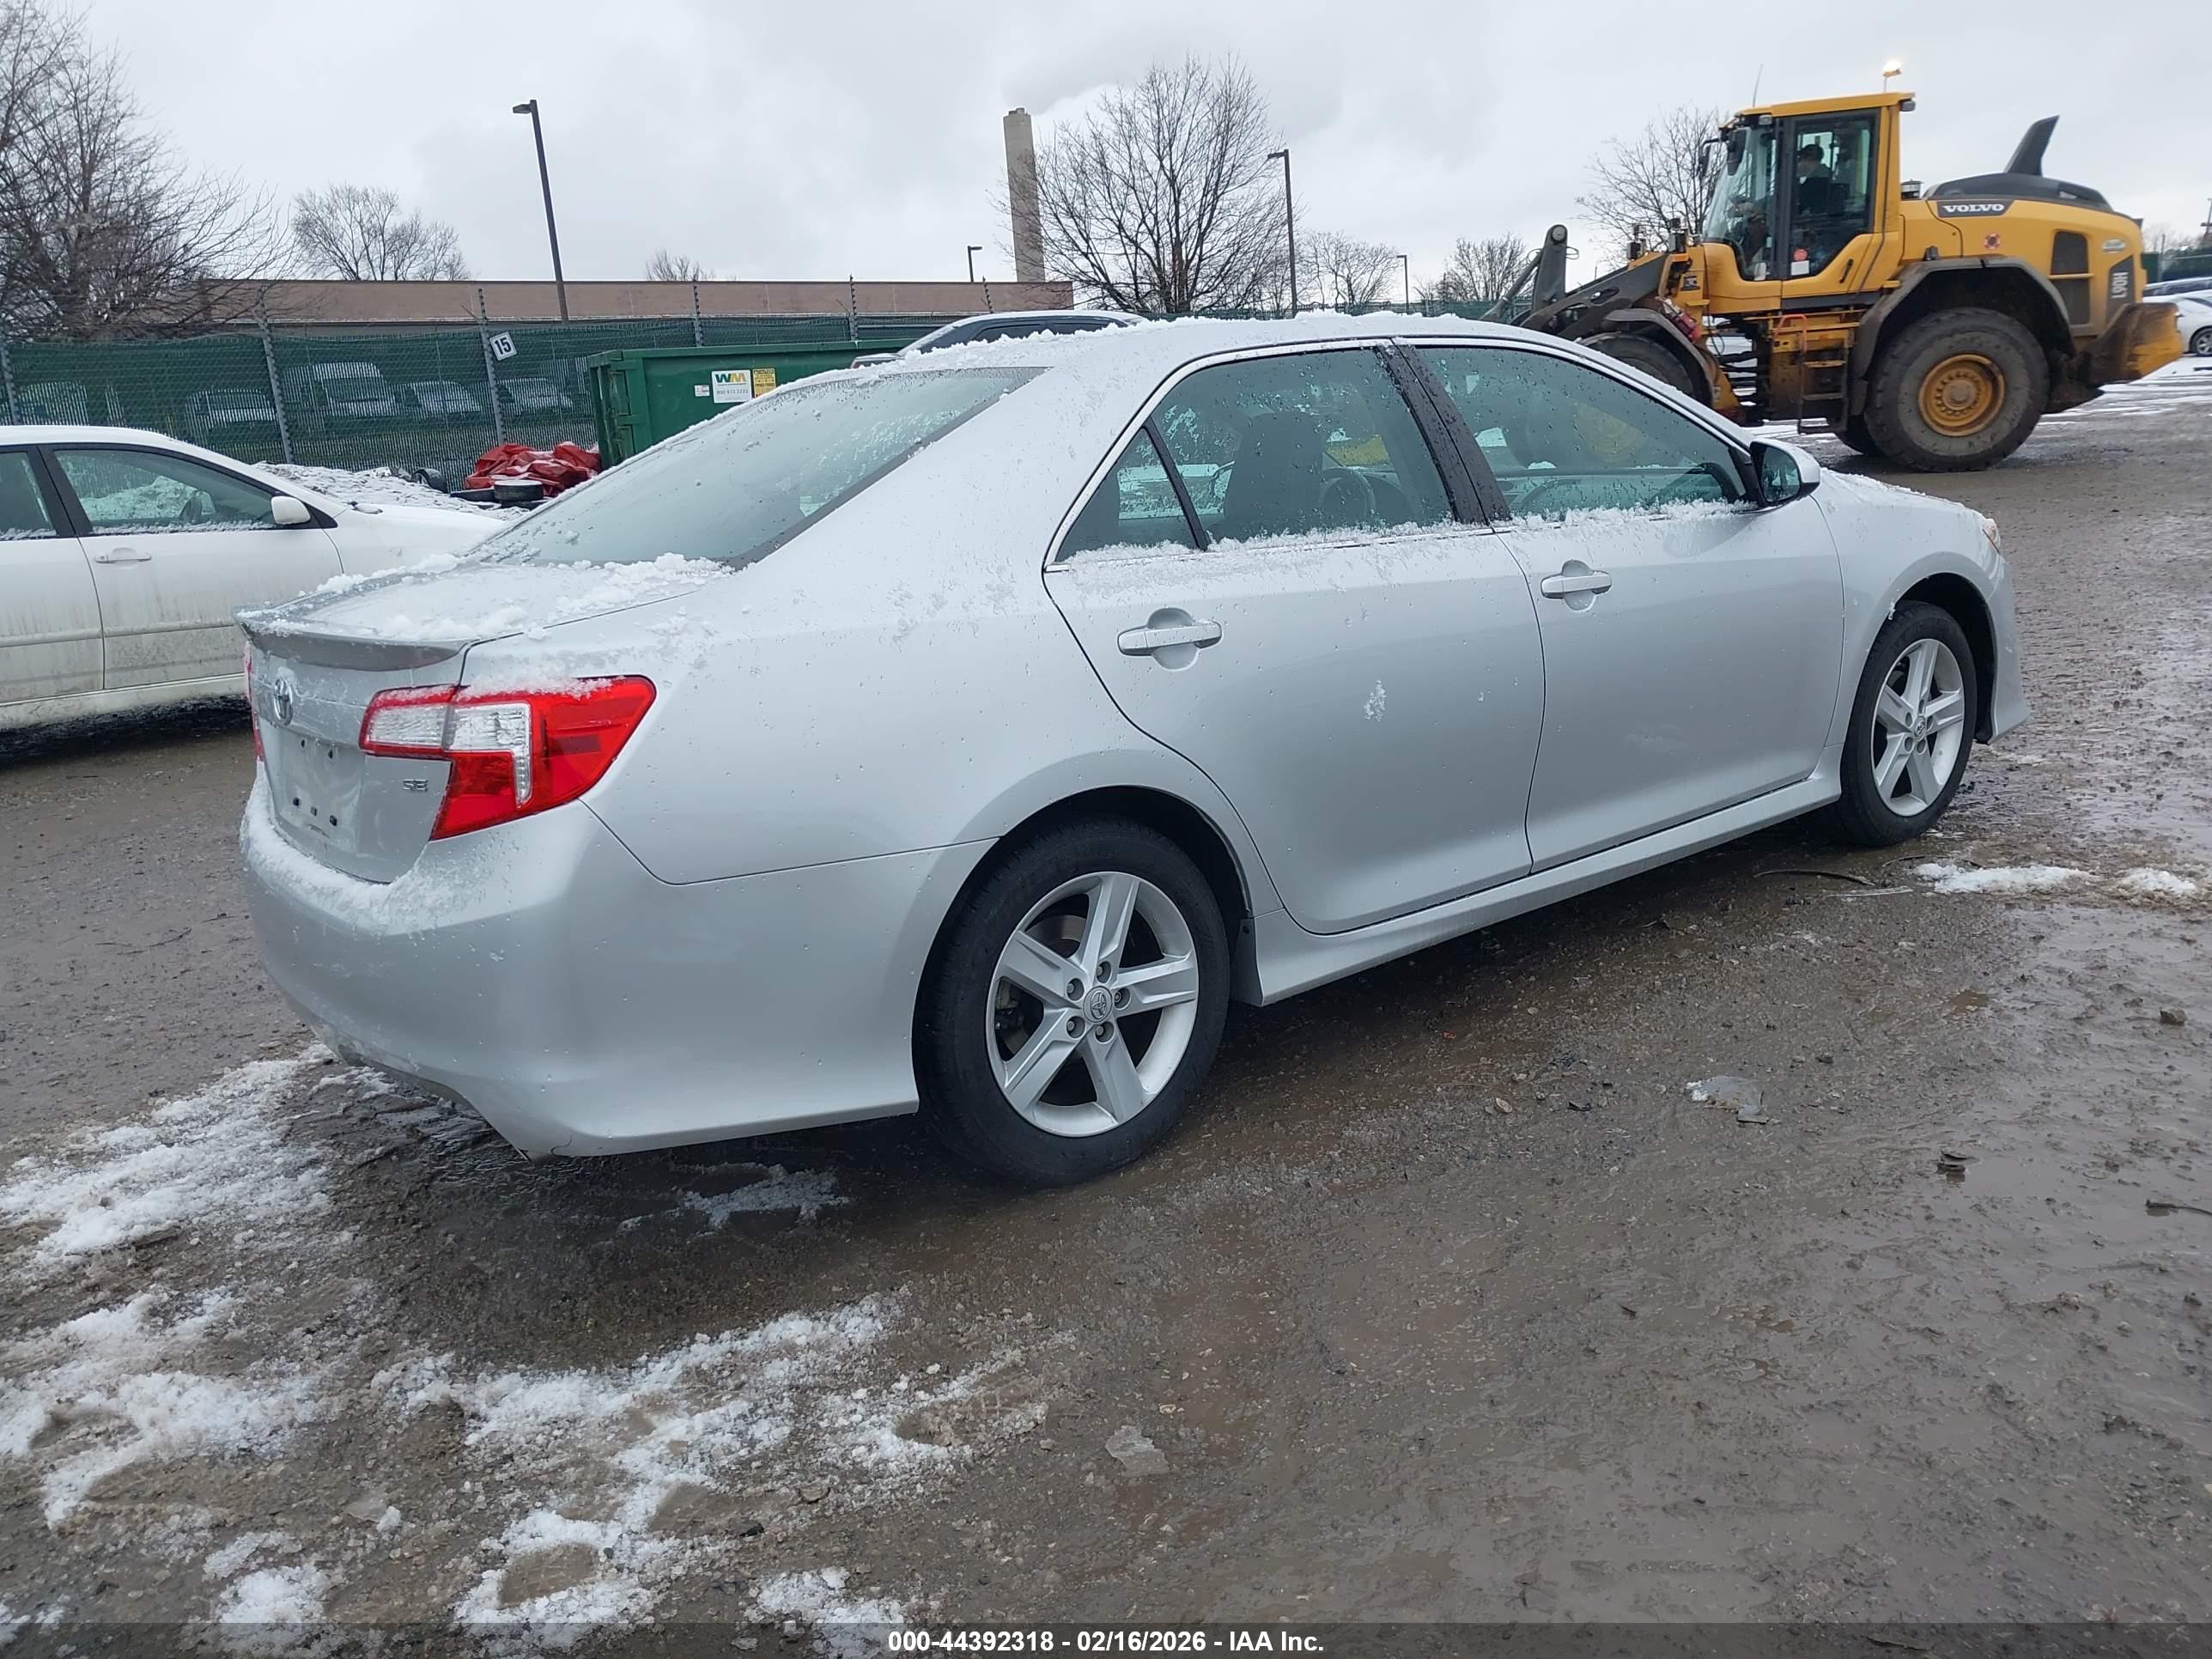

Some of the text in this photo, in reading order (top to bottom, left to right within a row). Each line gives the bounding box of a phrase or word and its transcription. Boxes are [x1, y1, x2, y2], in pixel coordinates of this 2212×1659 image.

[1942, 204, 2005, 213] VOLVO
[2112, 271, 2130, 299] L90H
[494, 337, 512, 355] 15
[714, 373, 747, 383] WM
[403, 778, 428, 791] SE
